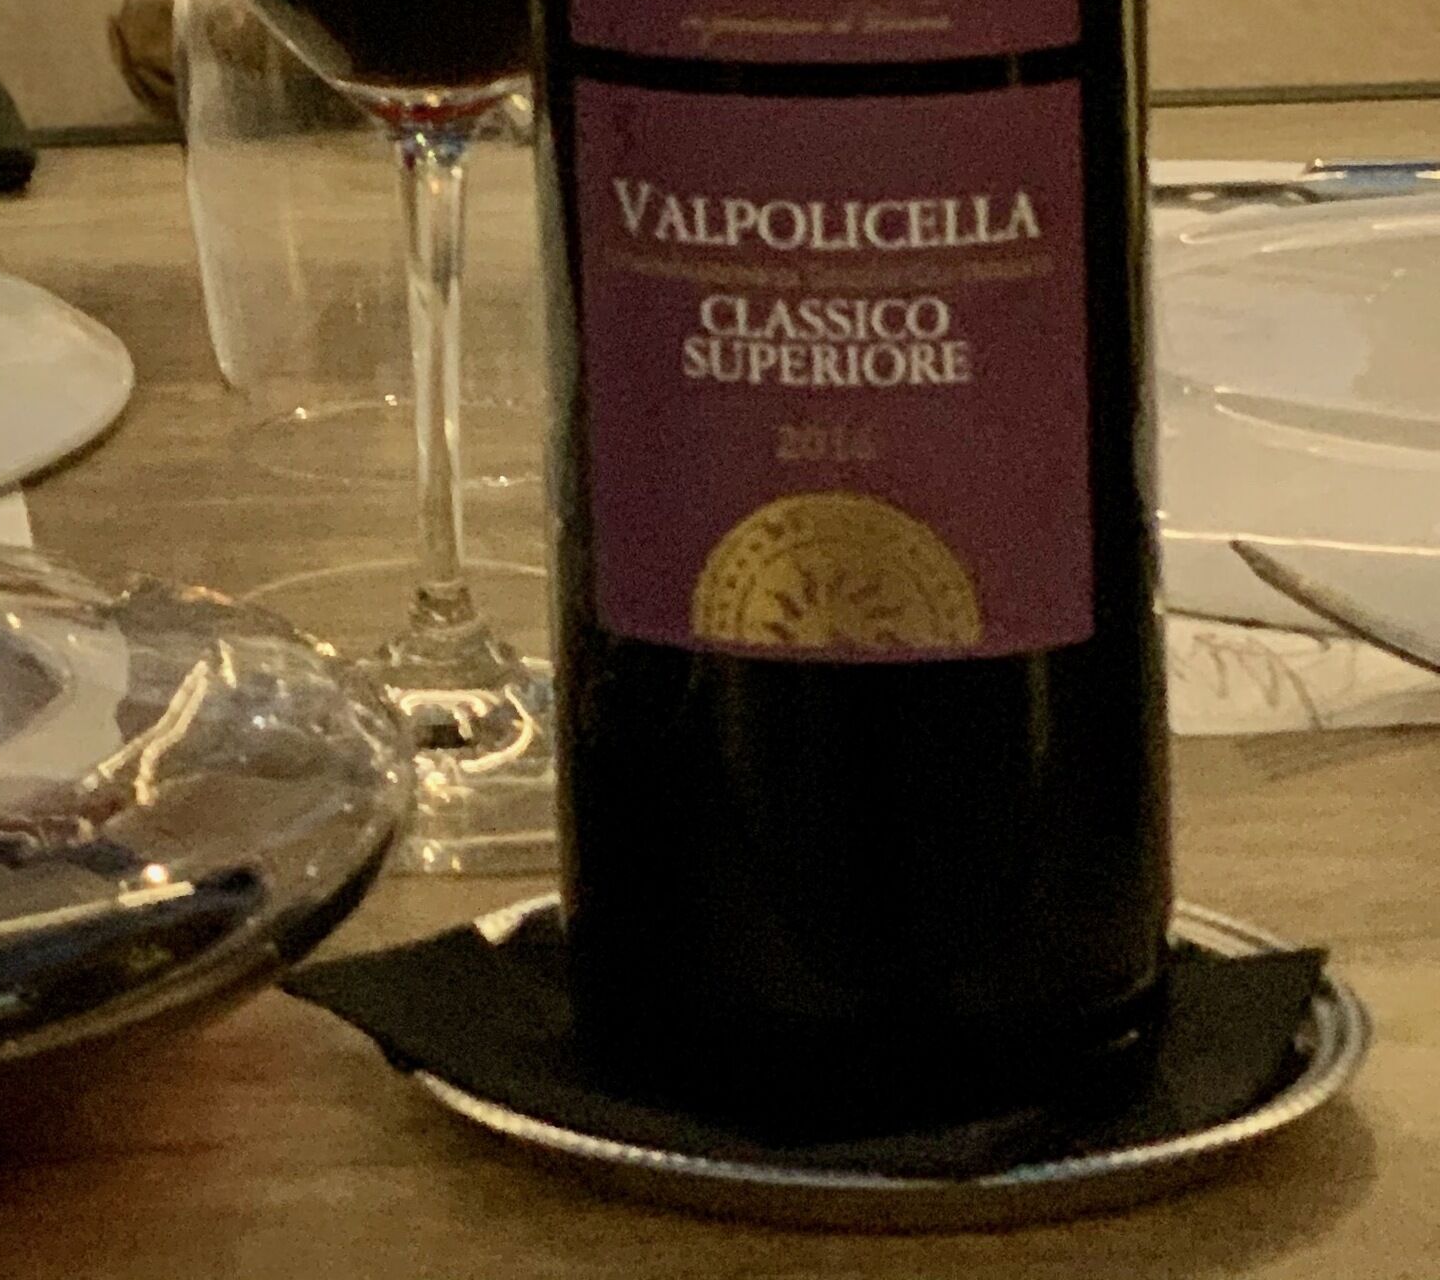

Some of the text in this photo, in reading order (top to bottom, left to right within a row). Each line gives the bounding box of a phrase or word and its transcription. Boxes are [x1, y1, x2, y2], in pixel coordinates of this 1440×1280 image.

[612, 176, 1041, 252] VALPOLICELLA
[699, 294, 951, 341] CLASSICO
[681, 339, 973, 386] SUPERIORE
